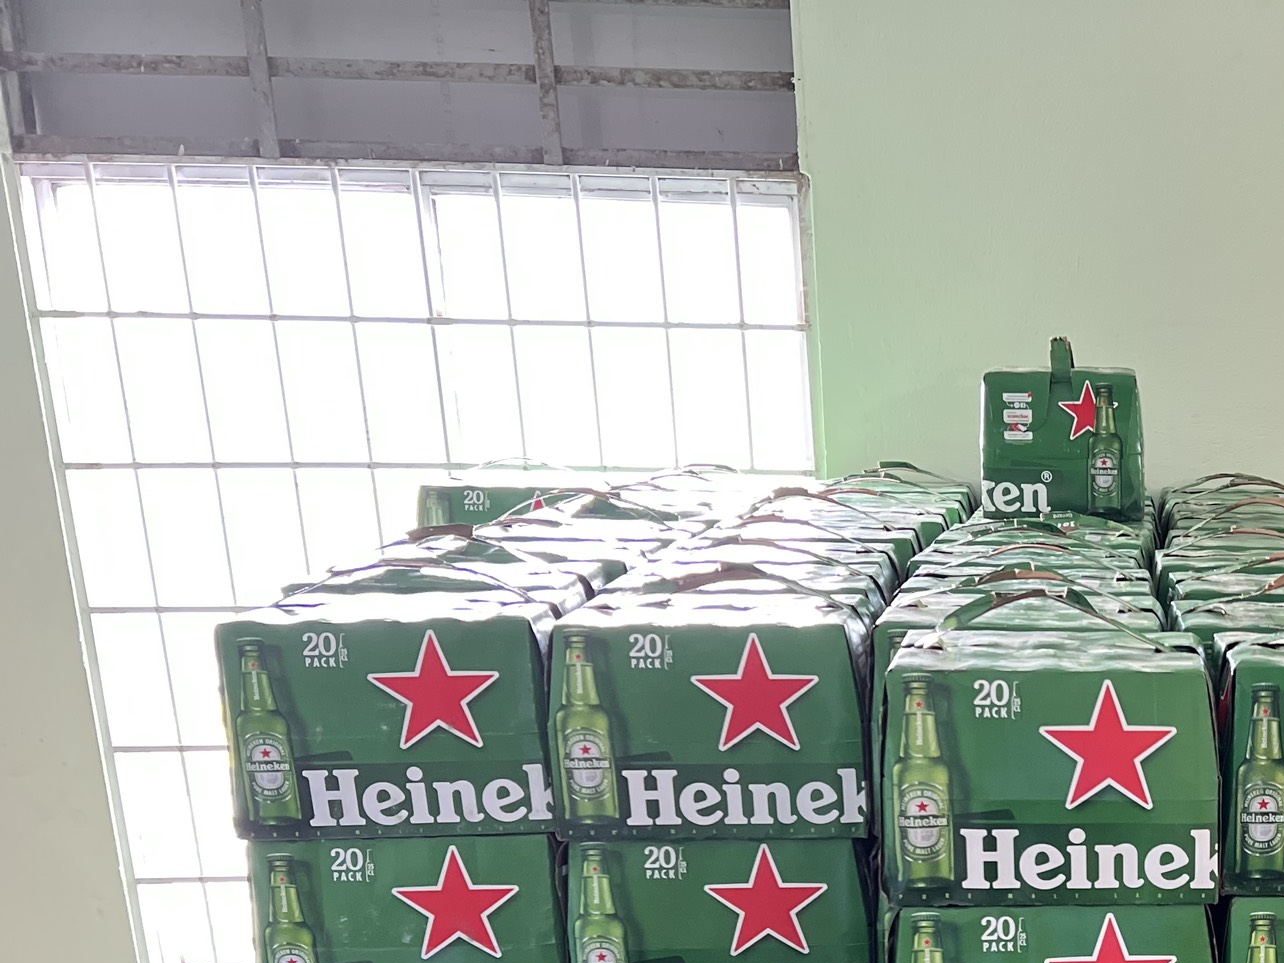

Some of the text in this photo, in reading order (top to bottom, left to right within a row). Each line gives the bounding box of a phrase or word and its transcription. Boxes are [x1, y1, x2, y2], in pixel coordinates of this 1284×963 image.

[464, 490, 483, 504] 20
[302, 632, 336, 656] 20
[629, 634, 661, 657] 20
[305, 657, 336, 668] PACK
[973, 680, 1009, 706] 20
[302, 764, 553, 827] Heinek
[621, 768, 867, 826] Heinek
[331, 848, 363, 871] 20
[644, 846, 676, 869] 20
[960, 828, 1219, 890] Heinek
[334, 872, 362, 882] PACK
[981, 916, 1015, 941] 20
